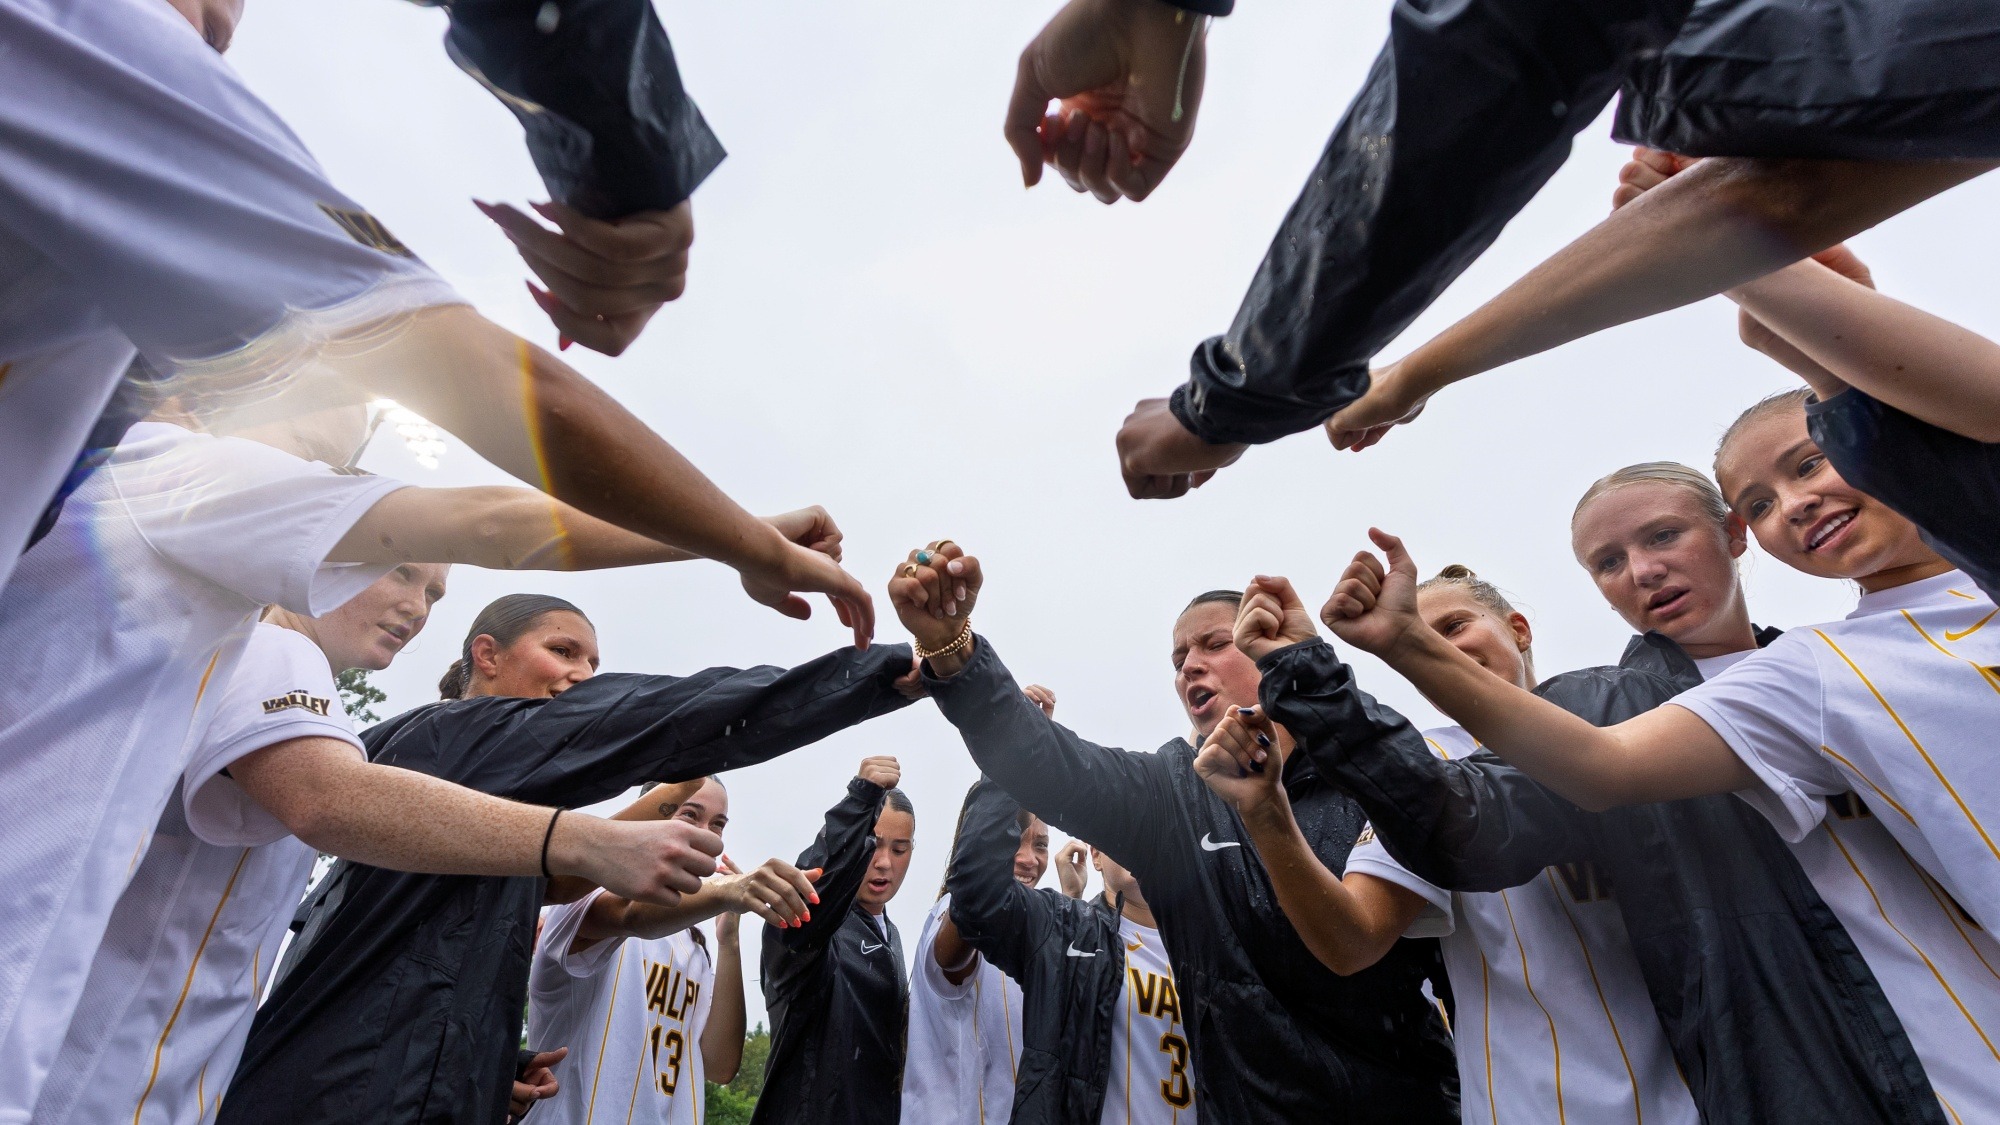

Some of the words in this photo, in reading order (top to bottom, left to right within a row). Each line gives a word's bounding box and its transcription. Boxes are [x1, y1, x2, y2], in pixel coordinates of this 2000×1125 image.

[261, 694, 331, 717] VALLEY
[650, 1023, 685, 1097] 13
[1159, 1032, 1192, 1110] 3
